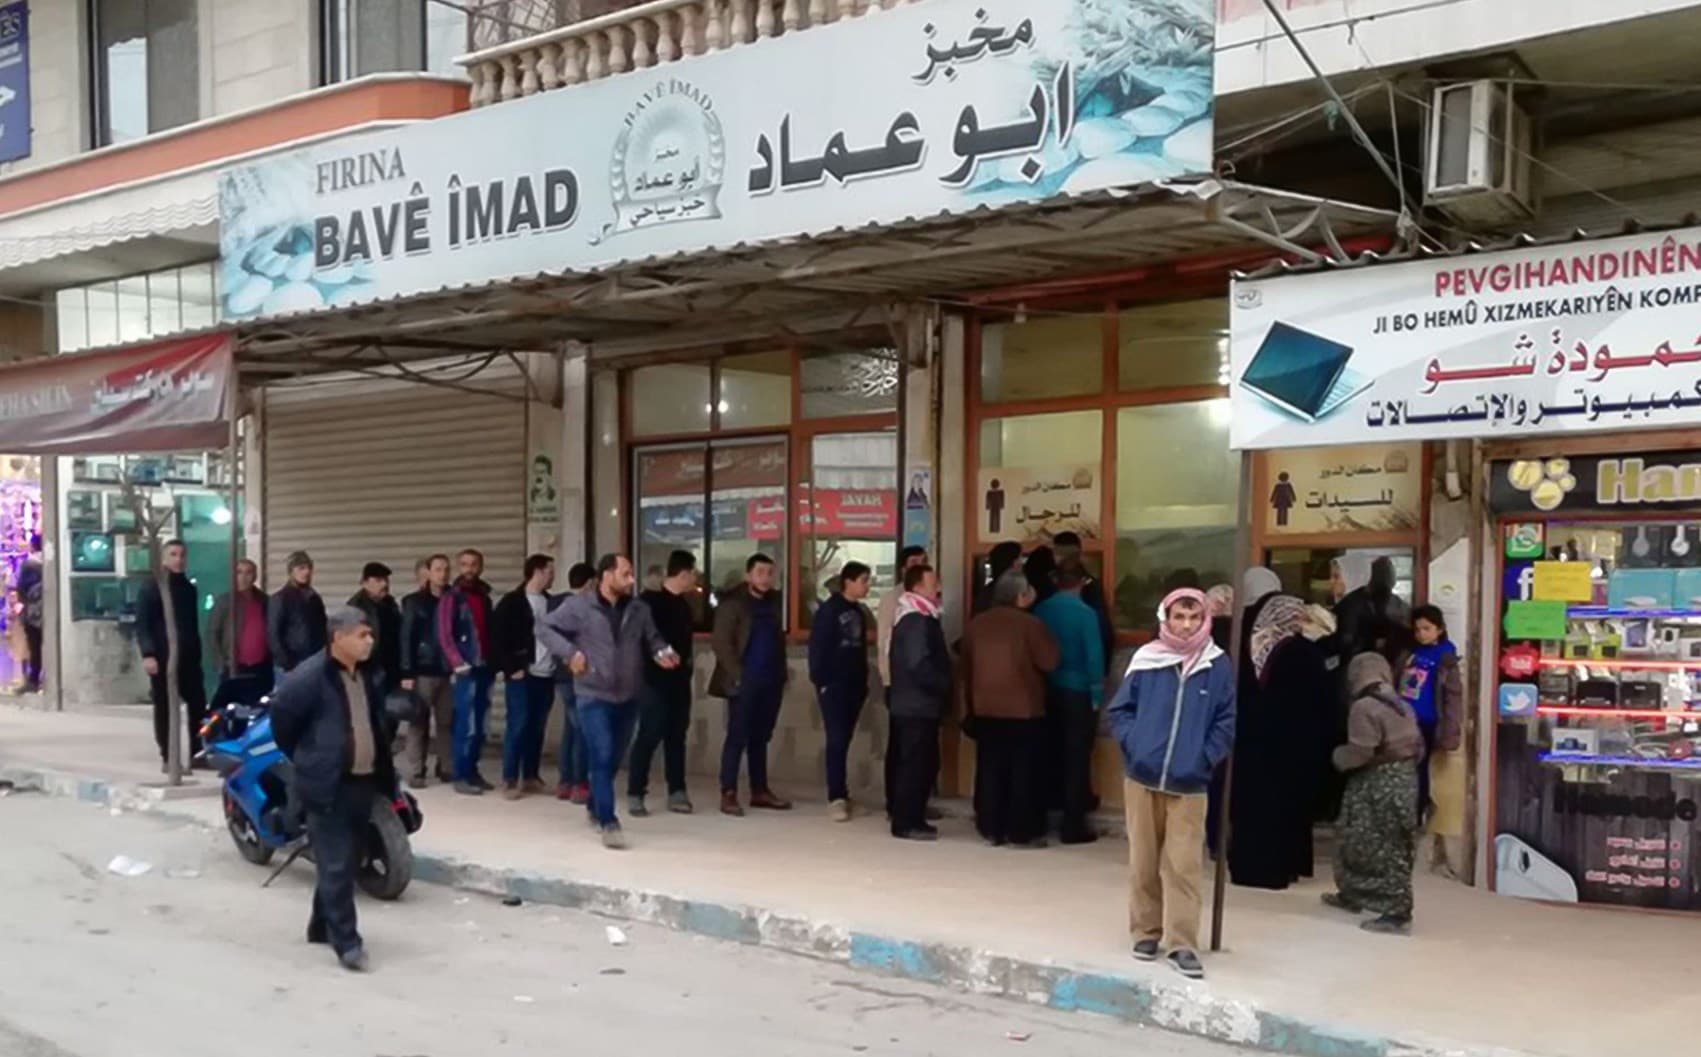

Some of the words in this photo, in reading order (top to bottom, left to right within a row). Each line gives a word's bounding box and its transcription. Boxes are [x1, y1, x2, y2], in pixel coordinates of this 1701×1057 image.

[911, 8, 1034, 81] مخبز
[748, 111, 926, 192] عماد
[938, 61, 1073, 182] ابو
[315, 147, 406, 194] FIRINA
[634, 170, 673, 193] عماد
[315, 181, 431, 269] BAVÊ
[447, 168, 580, 248] ÎMAD
[1435, 235, 1701, 297] PEVGIHANDINÊN
[1373, 316, 1387, 333] JI
[1393, 313, 1418, 333] BO
[1424, 299, 1477, 329] HEMÛ
[1484, 286, 1632, 323] XIZMEKARIYÊN
[1420, 333, 1537, 394] شو
[1015, 502, 1081, 524] للرجال
[1305, 488, 1393, 513] للسيدات
